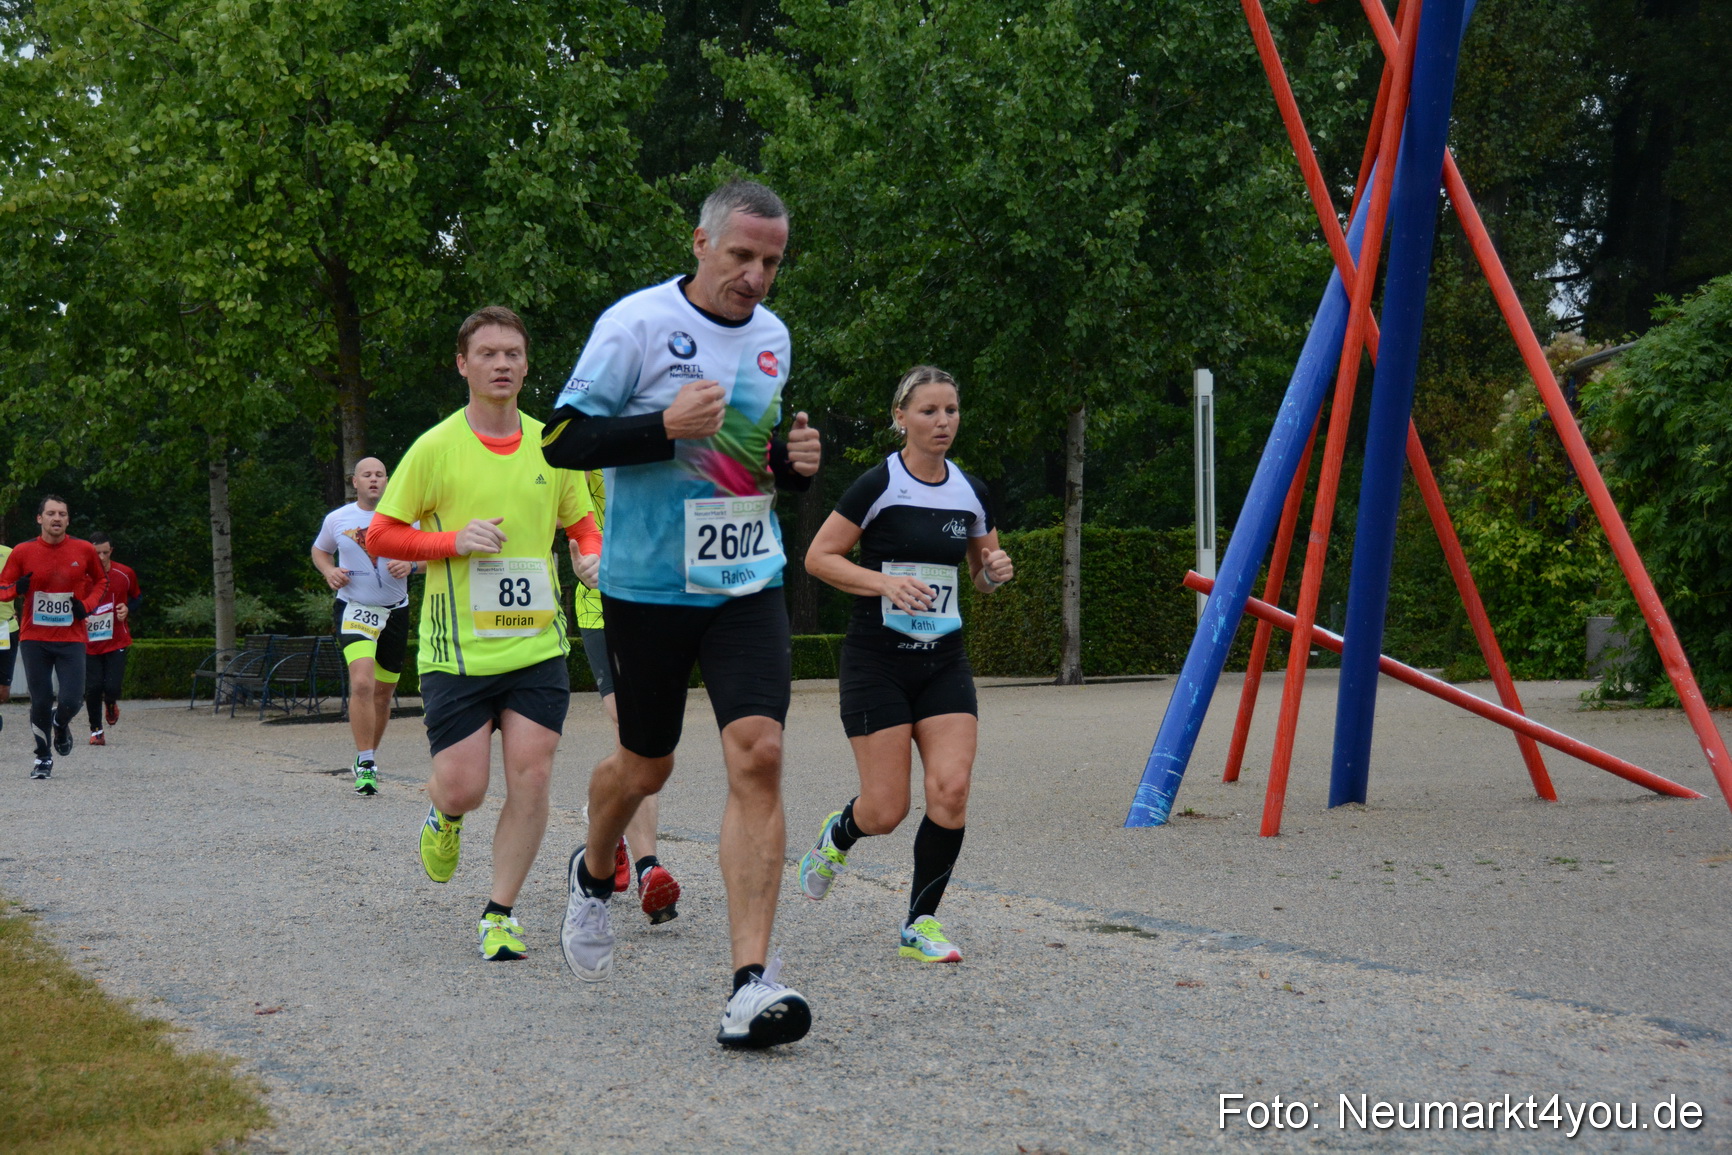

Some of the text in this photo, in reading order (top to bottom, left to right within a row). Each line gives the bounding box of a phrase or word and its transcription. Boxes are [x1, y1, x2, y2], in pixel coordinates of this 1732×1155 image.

[670, 364, 703, 373] PARTL
[698, 520, 770, 560] 2602
[509, 561, 543, 571] BOCK
[721, 568, 756, 585] Ralph
[498, 577, 532, 607] 83
[37, 599, 70, 614] 2896
[353, 608, 379, 626] 239
[495, 614, 534, 626] Florian
[87, 619, 111, 632] 2624
[911, 619, 936, 631] Kathi
